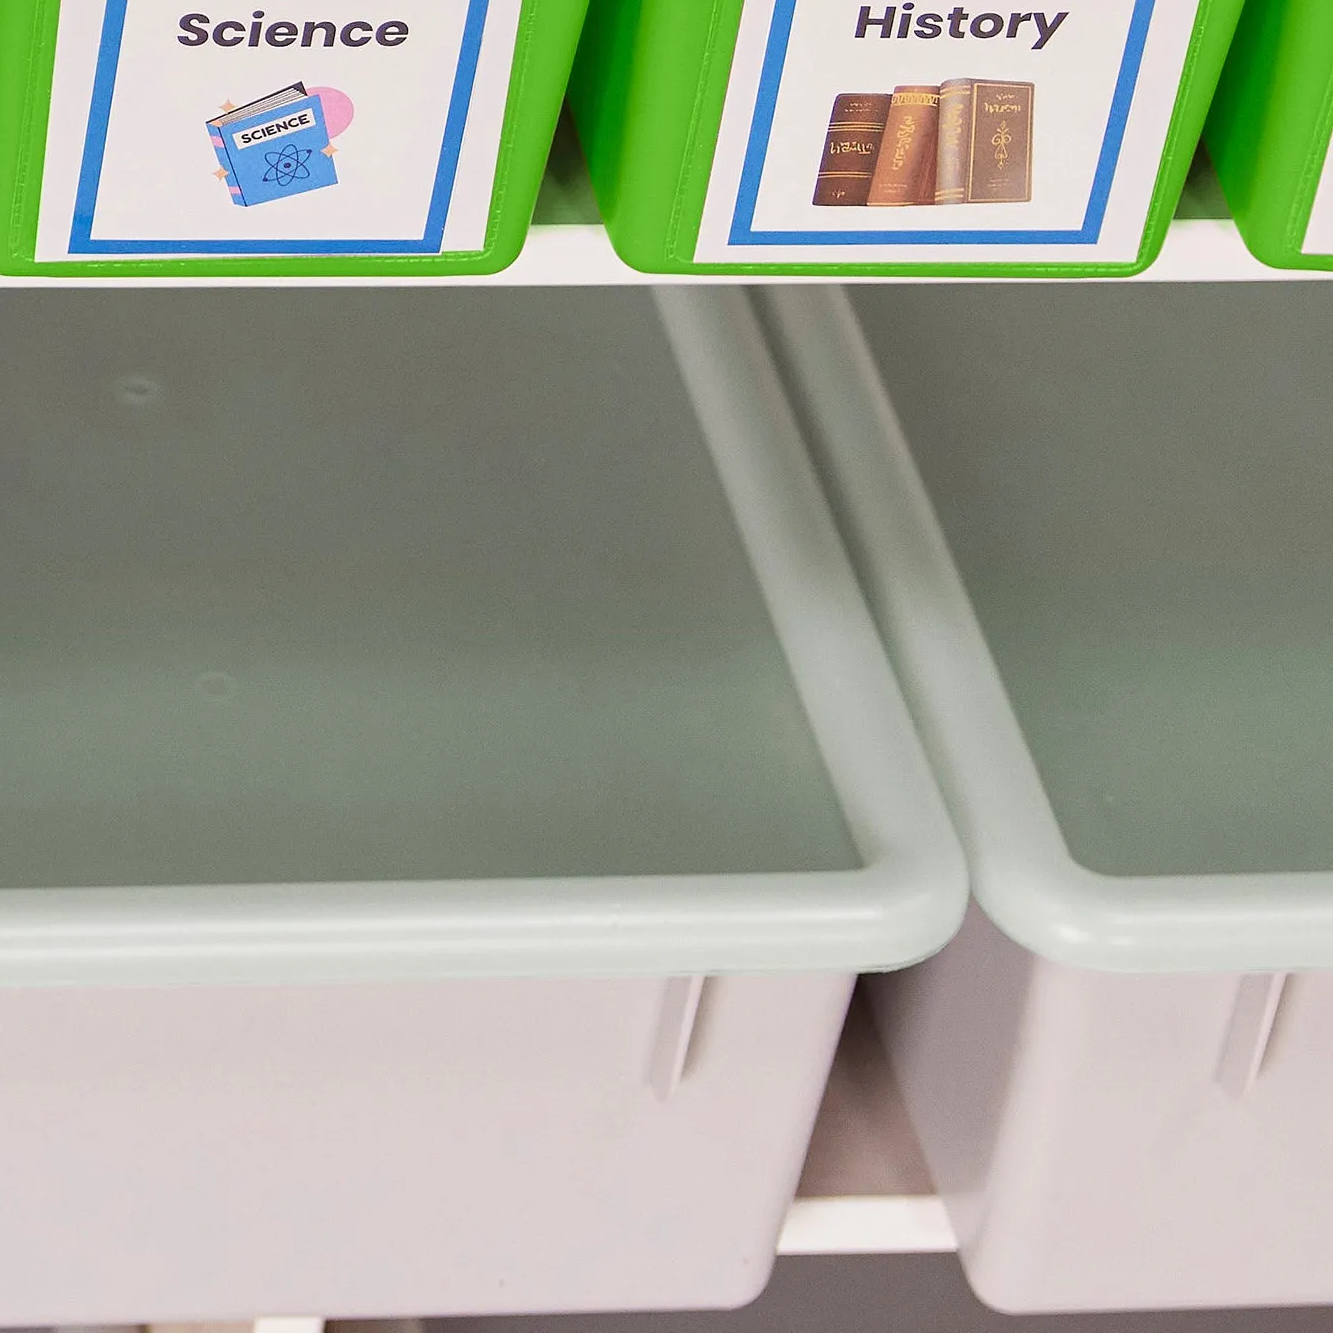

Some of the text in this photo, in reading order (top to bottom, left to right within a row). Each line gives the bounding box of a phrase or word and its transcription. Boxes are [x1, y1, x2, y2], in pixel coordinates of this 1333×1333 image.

[176, 9, 410, 49] Science
[854, 2, 1070, 51] History
[240, 113, 311, 144] SCIENCE
